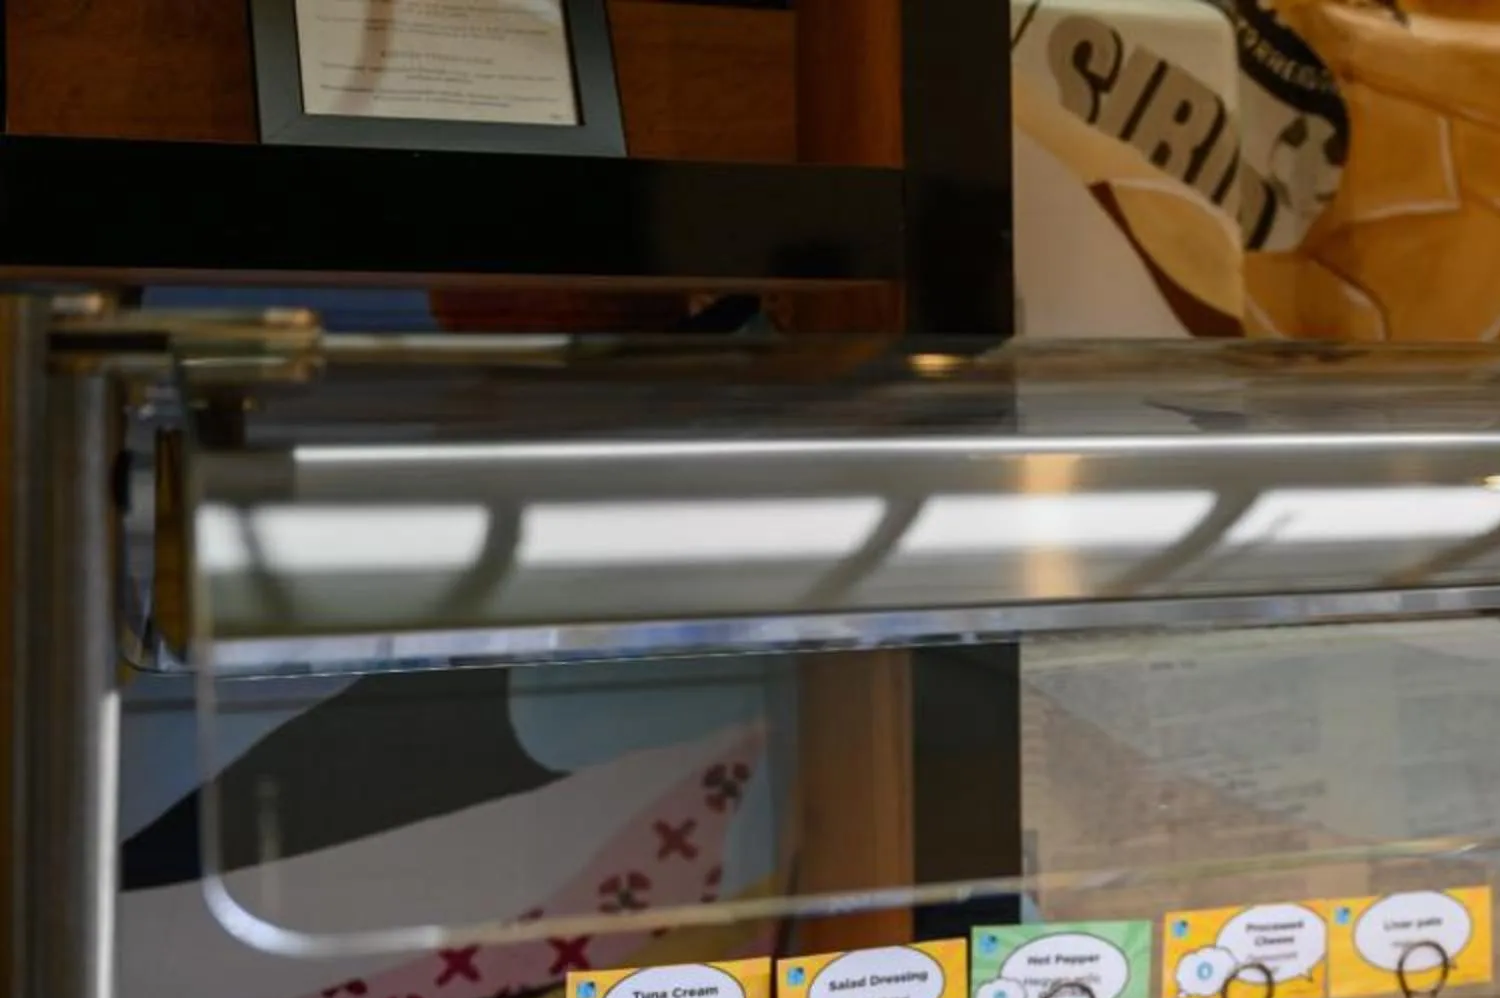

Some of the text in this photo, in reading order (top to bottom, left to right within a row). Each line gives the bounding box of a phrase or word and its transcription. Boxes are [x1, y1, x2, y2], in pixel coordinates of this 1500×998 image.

[828, 970, 929, 991] Salad Dressing
[672, 985, 719, 998] Cream
